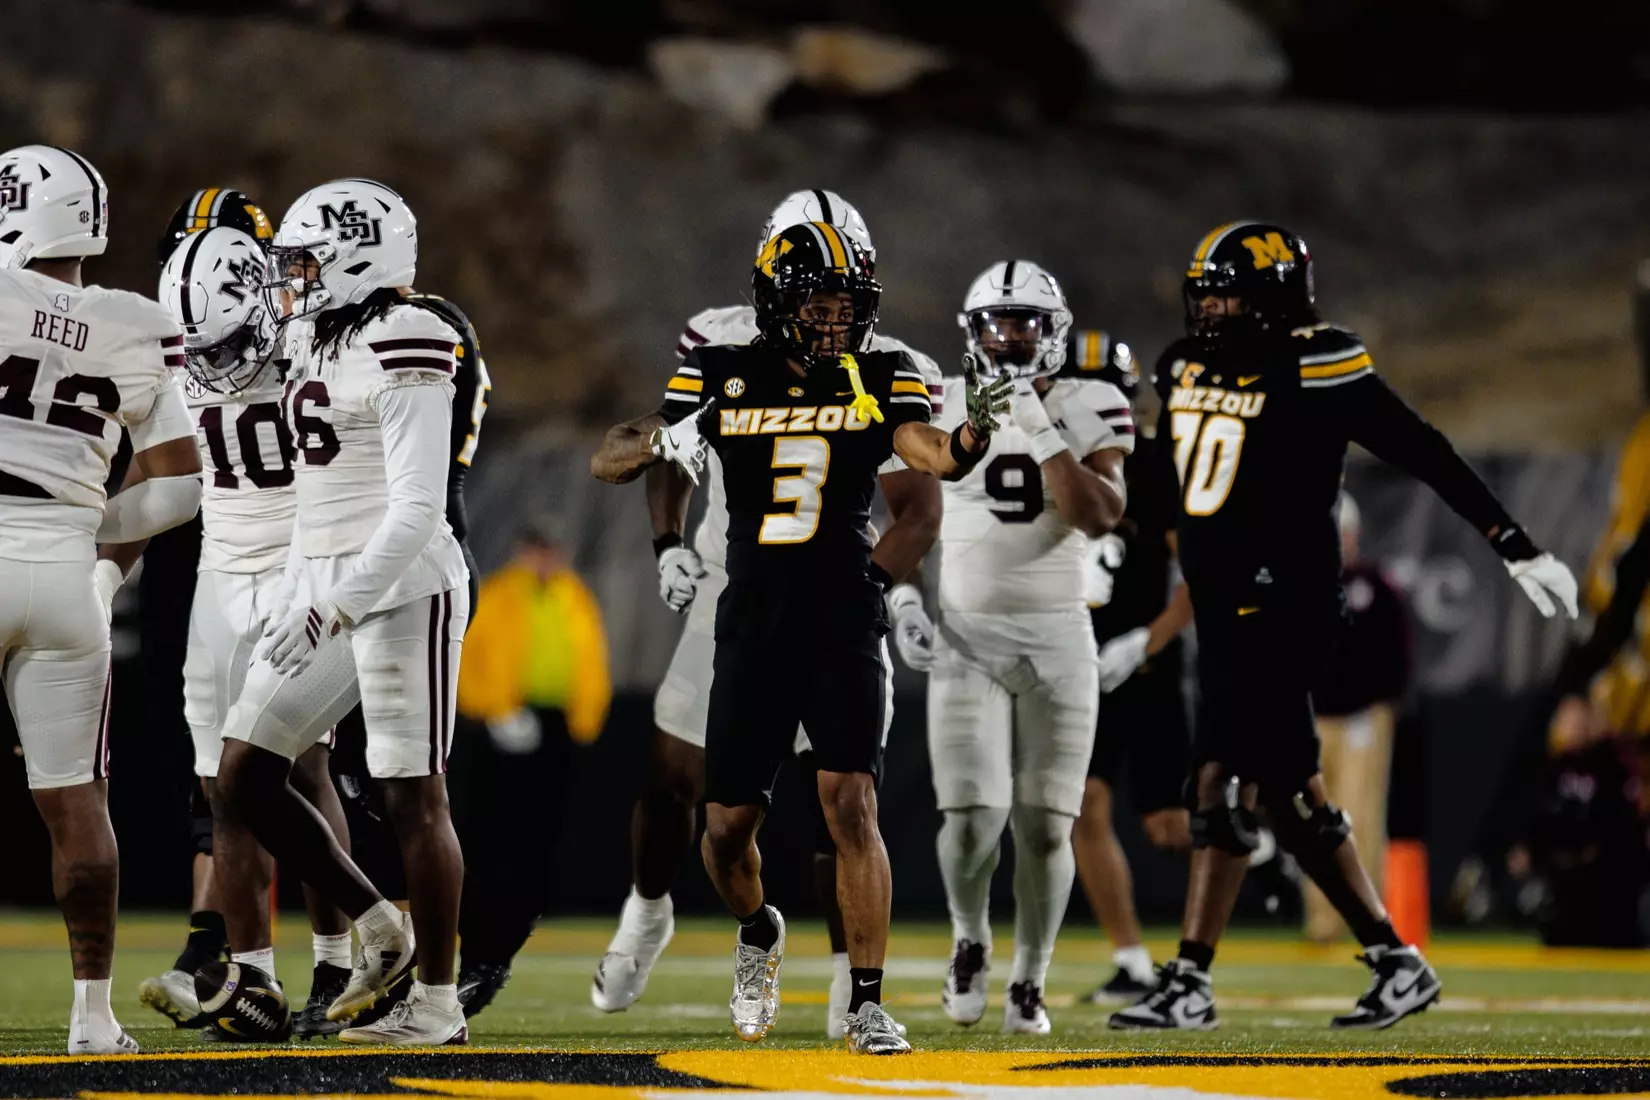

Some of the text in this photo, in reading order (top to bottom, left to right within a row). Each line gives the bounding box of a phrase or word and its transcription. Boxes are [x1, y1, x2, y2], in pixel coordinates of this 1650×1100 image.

[0, 164, 32, 212] SU
[317, 200, 381, 247] MSU
[1242, 232, 1295, 270] M
[31, 309, 89, 352] REED
[724, 377, 746, 398] SEC
[720, 405, 872, 436] MIZZOU
[198, 402, 295, 489] 10
[1171, 410, 1246, 517] 70
[758, 435, 831, 544] 3
[985, 453, 1044, 524] 9
